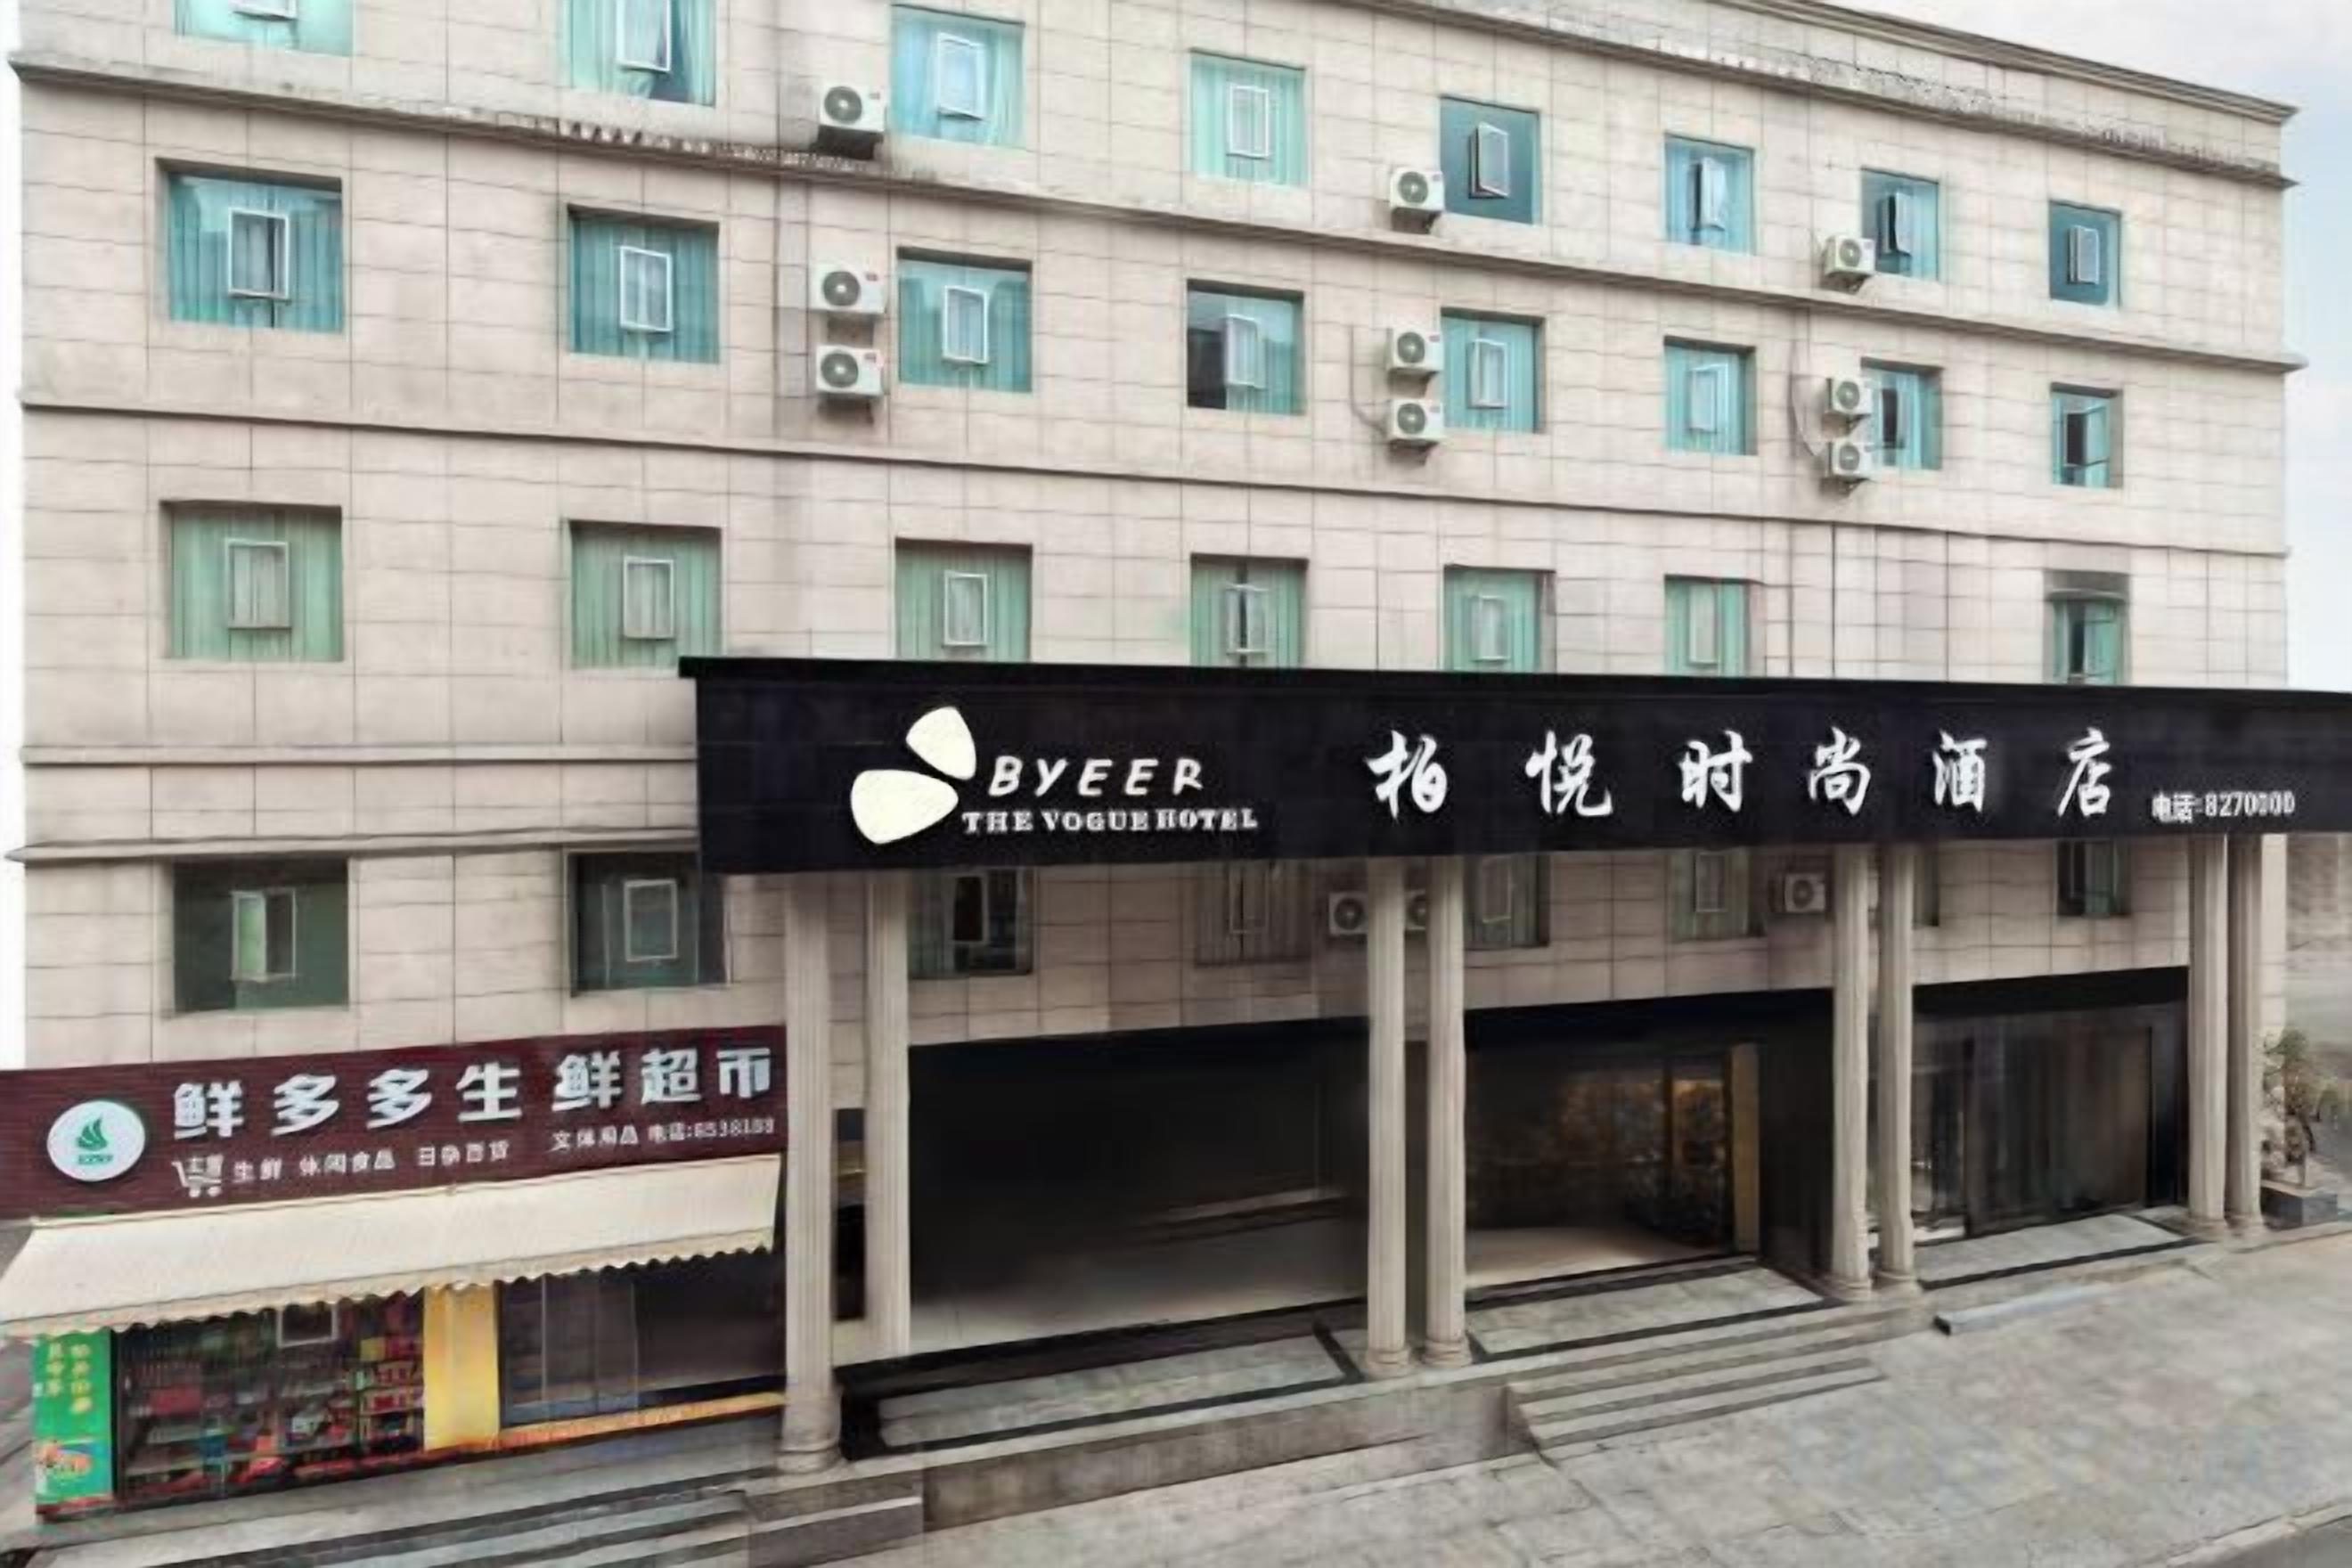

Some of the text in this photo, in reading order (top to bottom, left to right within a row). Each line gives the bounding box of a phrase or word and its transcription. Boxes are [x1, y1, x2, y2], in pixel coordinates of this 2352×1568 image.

[988, 755, 1204, 797] BYEER
[1364, 725, 2116, 821] 柏悦时尚酒店
[962, 807, 1259, 834] THE VOGUE HOTEL
[173, 1047, 772, 1139] 鲜多多生鲜超市
